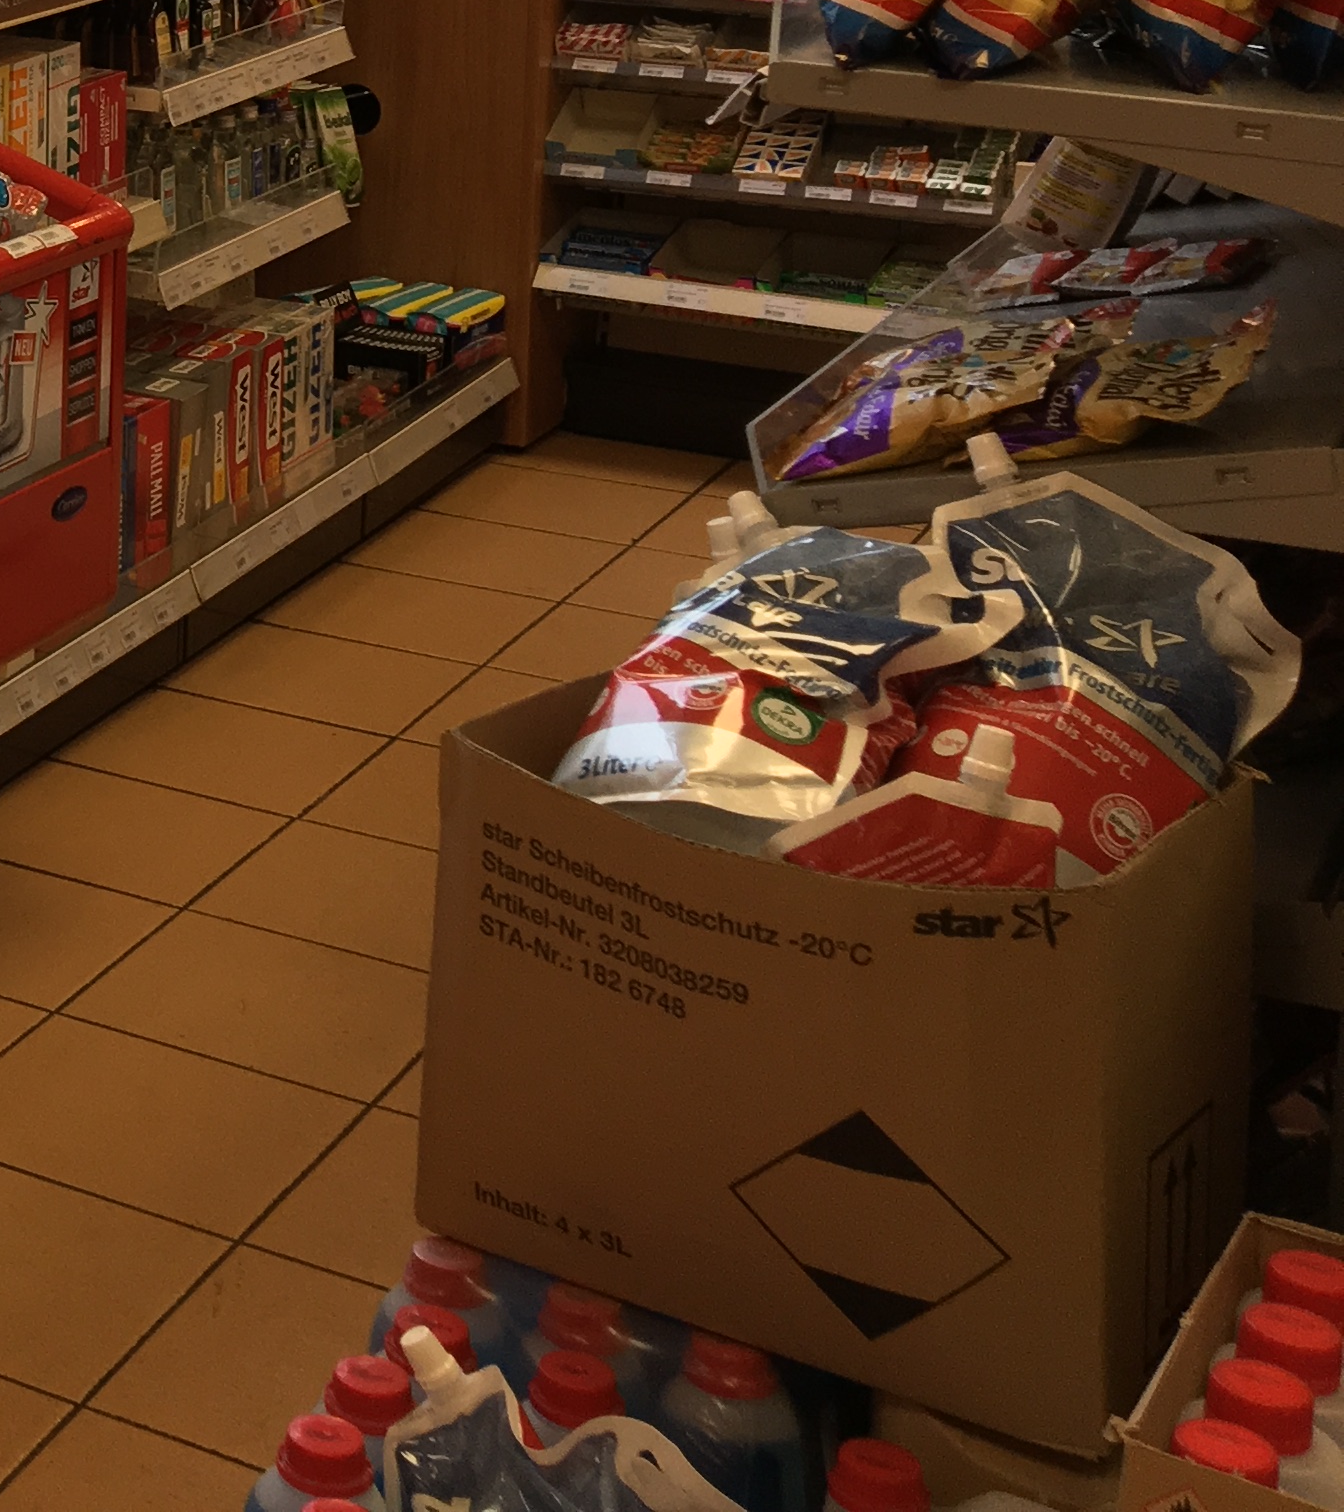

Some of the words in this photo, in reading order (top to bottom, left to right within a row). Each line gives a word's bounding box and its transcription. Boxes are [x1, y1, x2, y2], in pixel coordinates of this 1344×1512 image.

[71, 285, 91, 304] star
[14, 338, 34, 357] NEU
[309, 320, 323, 446] GIZEH
[237, 372, 250, 453] West
[267, 359, 281, 440] West
[282, 334, 298, 462] GIZEH
[150, 441, 164, 478] PALL
[149, 478, 163, 521] MALL
[761, 708, 804, 735] DEKRA
[1093, 721, 1149, 767] schnell
[482, 849, 615, 925] Standbeutel
[621, 910, 650, 940] 3L
[483, 820, 523, 851] star
[530, 838, 780, 947] Scheibenfrostschutz
[480, 883, 591, 948] Artikel-Nr.
[598, 932, 750, 1004] 3208038259
[913, 907, 1005, 940] star
[580, 958, 622, 994] 182
[628, 979, 686, 1020] 6748
[474, 1180, 549, 1229] Inhalt:
[554, 1214, 571, 1235] 4
[576, 1227, 593, 1244] x
[599, 1230, 633, 1261] 3L
